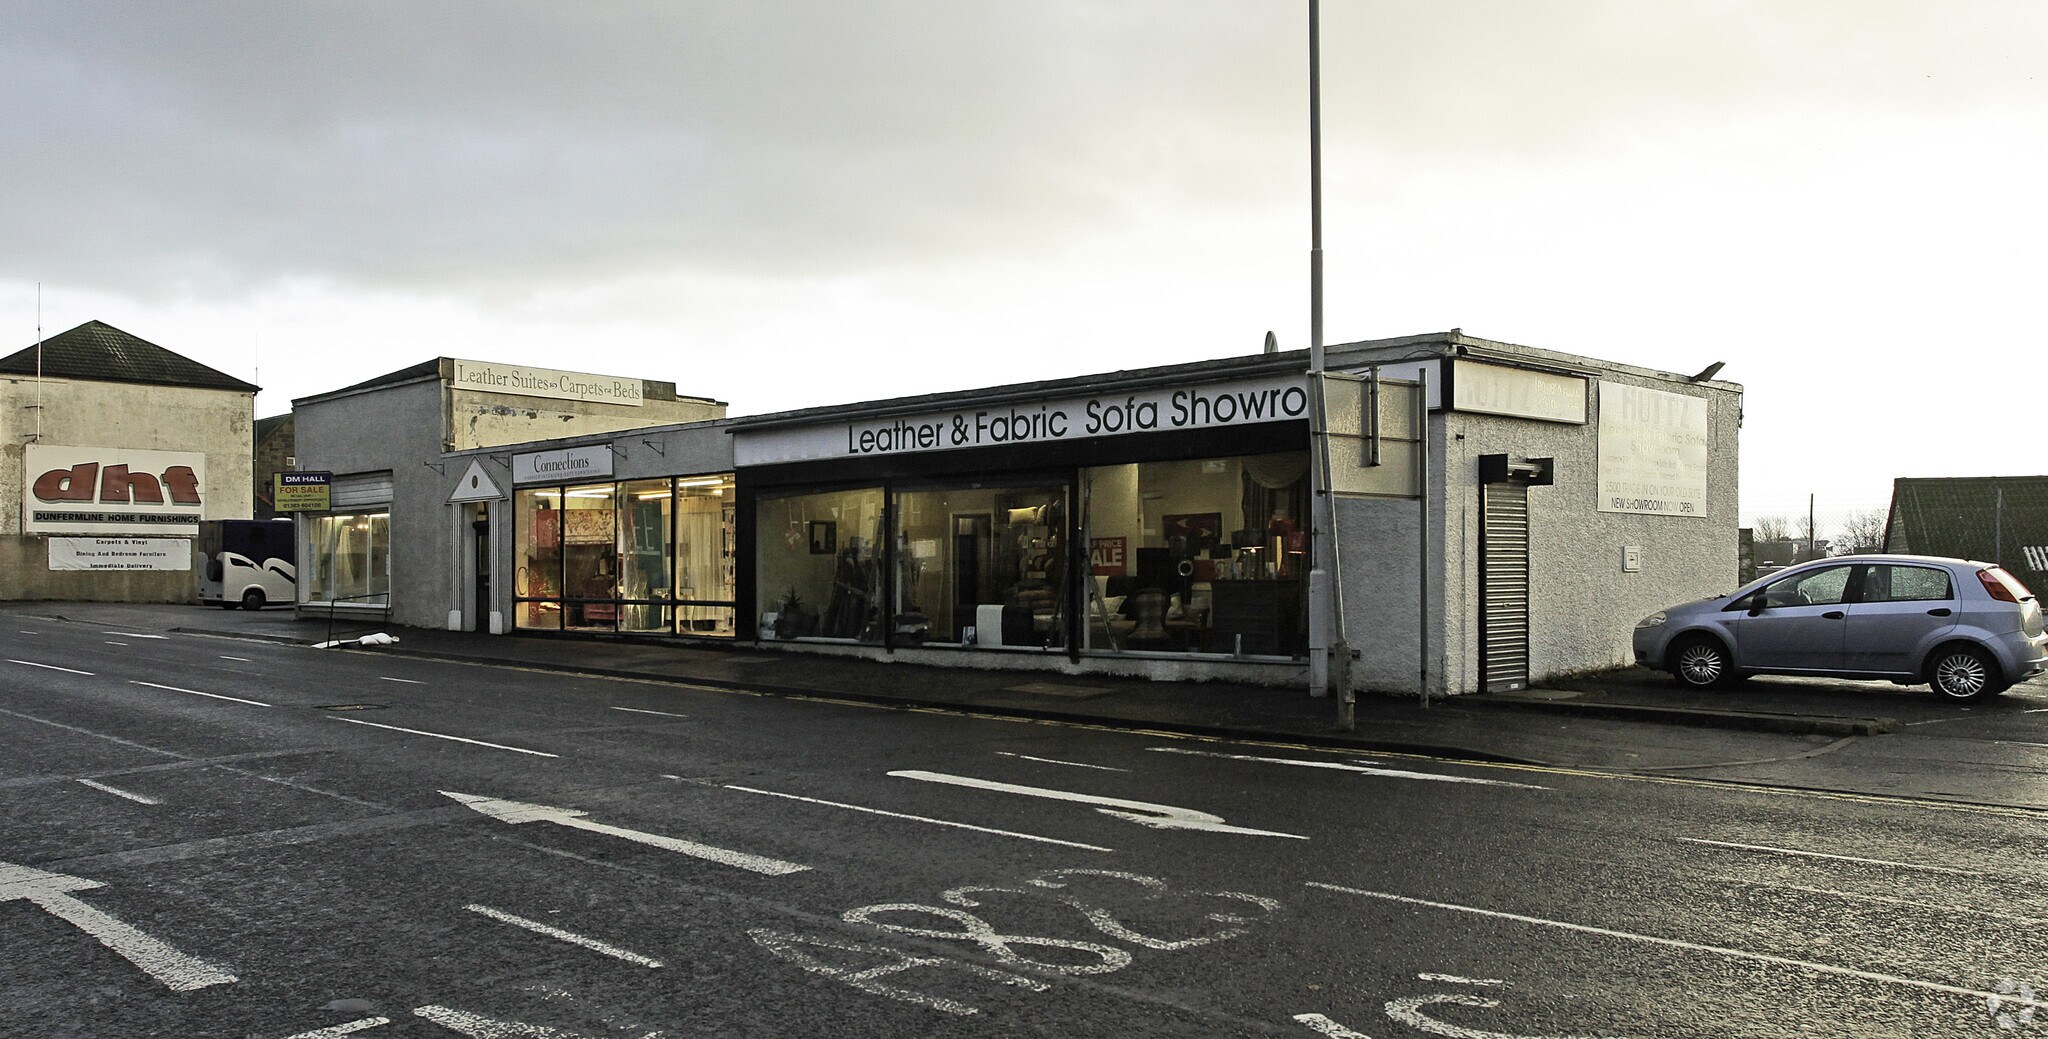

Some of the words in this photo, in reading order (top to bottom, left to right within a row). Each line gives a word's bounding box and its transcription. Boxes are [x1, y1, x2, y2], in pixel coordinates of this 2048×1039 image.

[457, 364, 509, 387] Leather
[511, 370, 549, 390] Suites
[559, 375, 604, 399] Carpets
[612, 381, 640, 400] Beds
[848, 419, 944, 454] Leather
[950, 413, 970, 446] &
[975, 405, 1068, 443] Fabric
[1085, 395, 1158, 434] Sofa
[1170, 386, 1307, 426] Showro
[1685, 433, 1705, 446] Sofa
[533, 452, 590, 473] Connections
[32, 461, 202, 506] dhf
[280, 486, 298, 494] FOR
[300, 486, 325, 494] SALE
[1622, 482, 1640, 494] TRADE
[1649, 484, 1658, 496] ON
[1660, 485, 1674, 497] YOUR
[1676, 486, 1687, 498] OLD
[1611, 497, 1626, 509] NEW
[1626, 498, 1663, 511] SHOWROOM
[1664, 500, 1679, 512] NOW
[1679, 501, 1695, 513] OPEN
[35, 512, 104, 522] DUNFERMLINE
[107, 514, 136, 522] HOME
[139, 514, 199, 524] FURNISHINGS
[1098, 540, 1122, 548] PRICE
[1090, 548, 1122, 567] ALE
